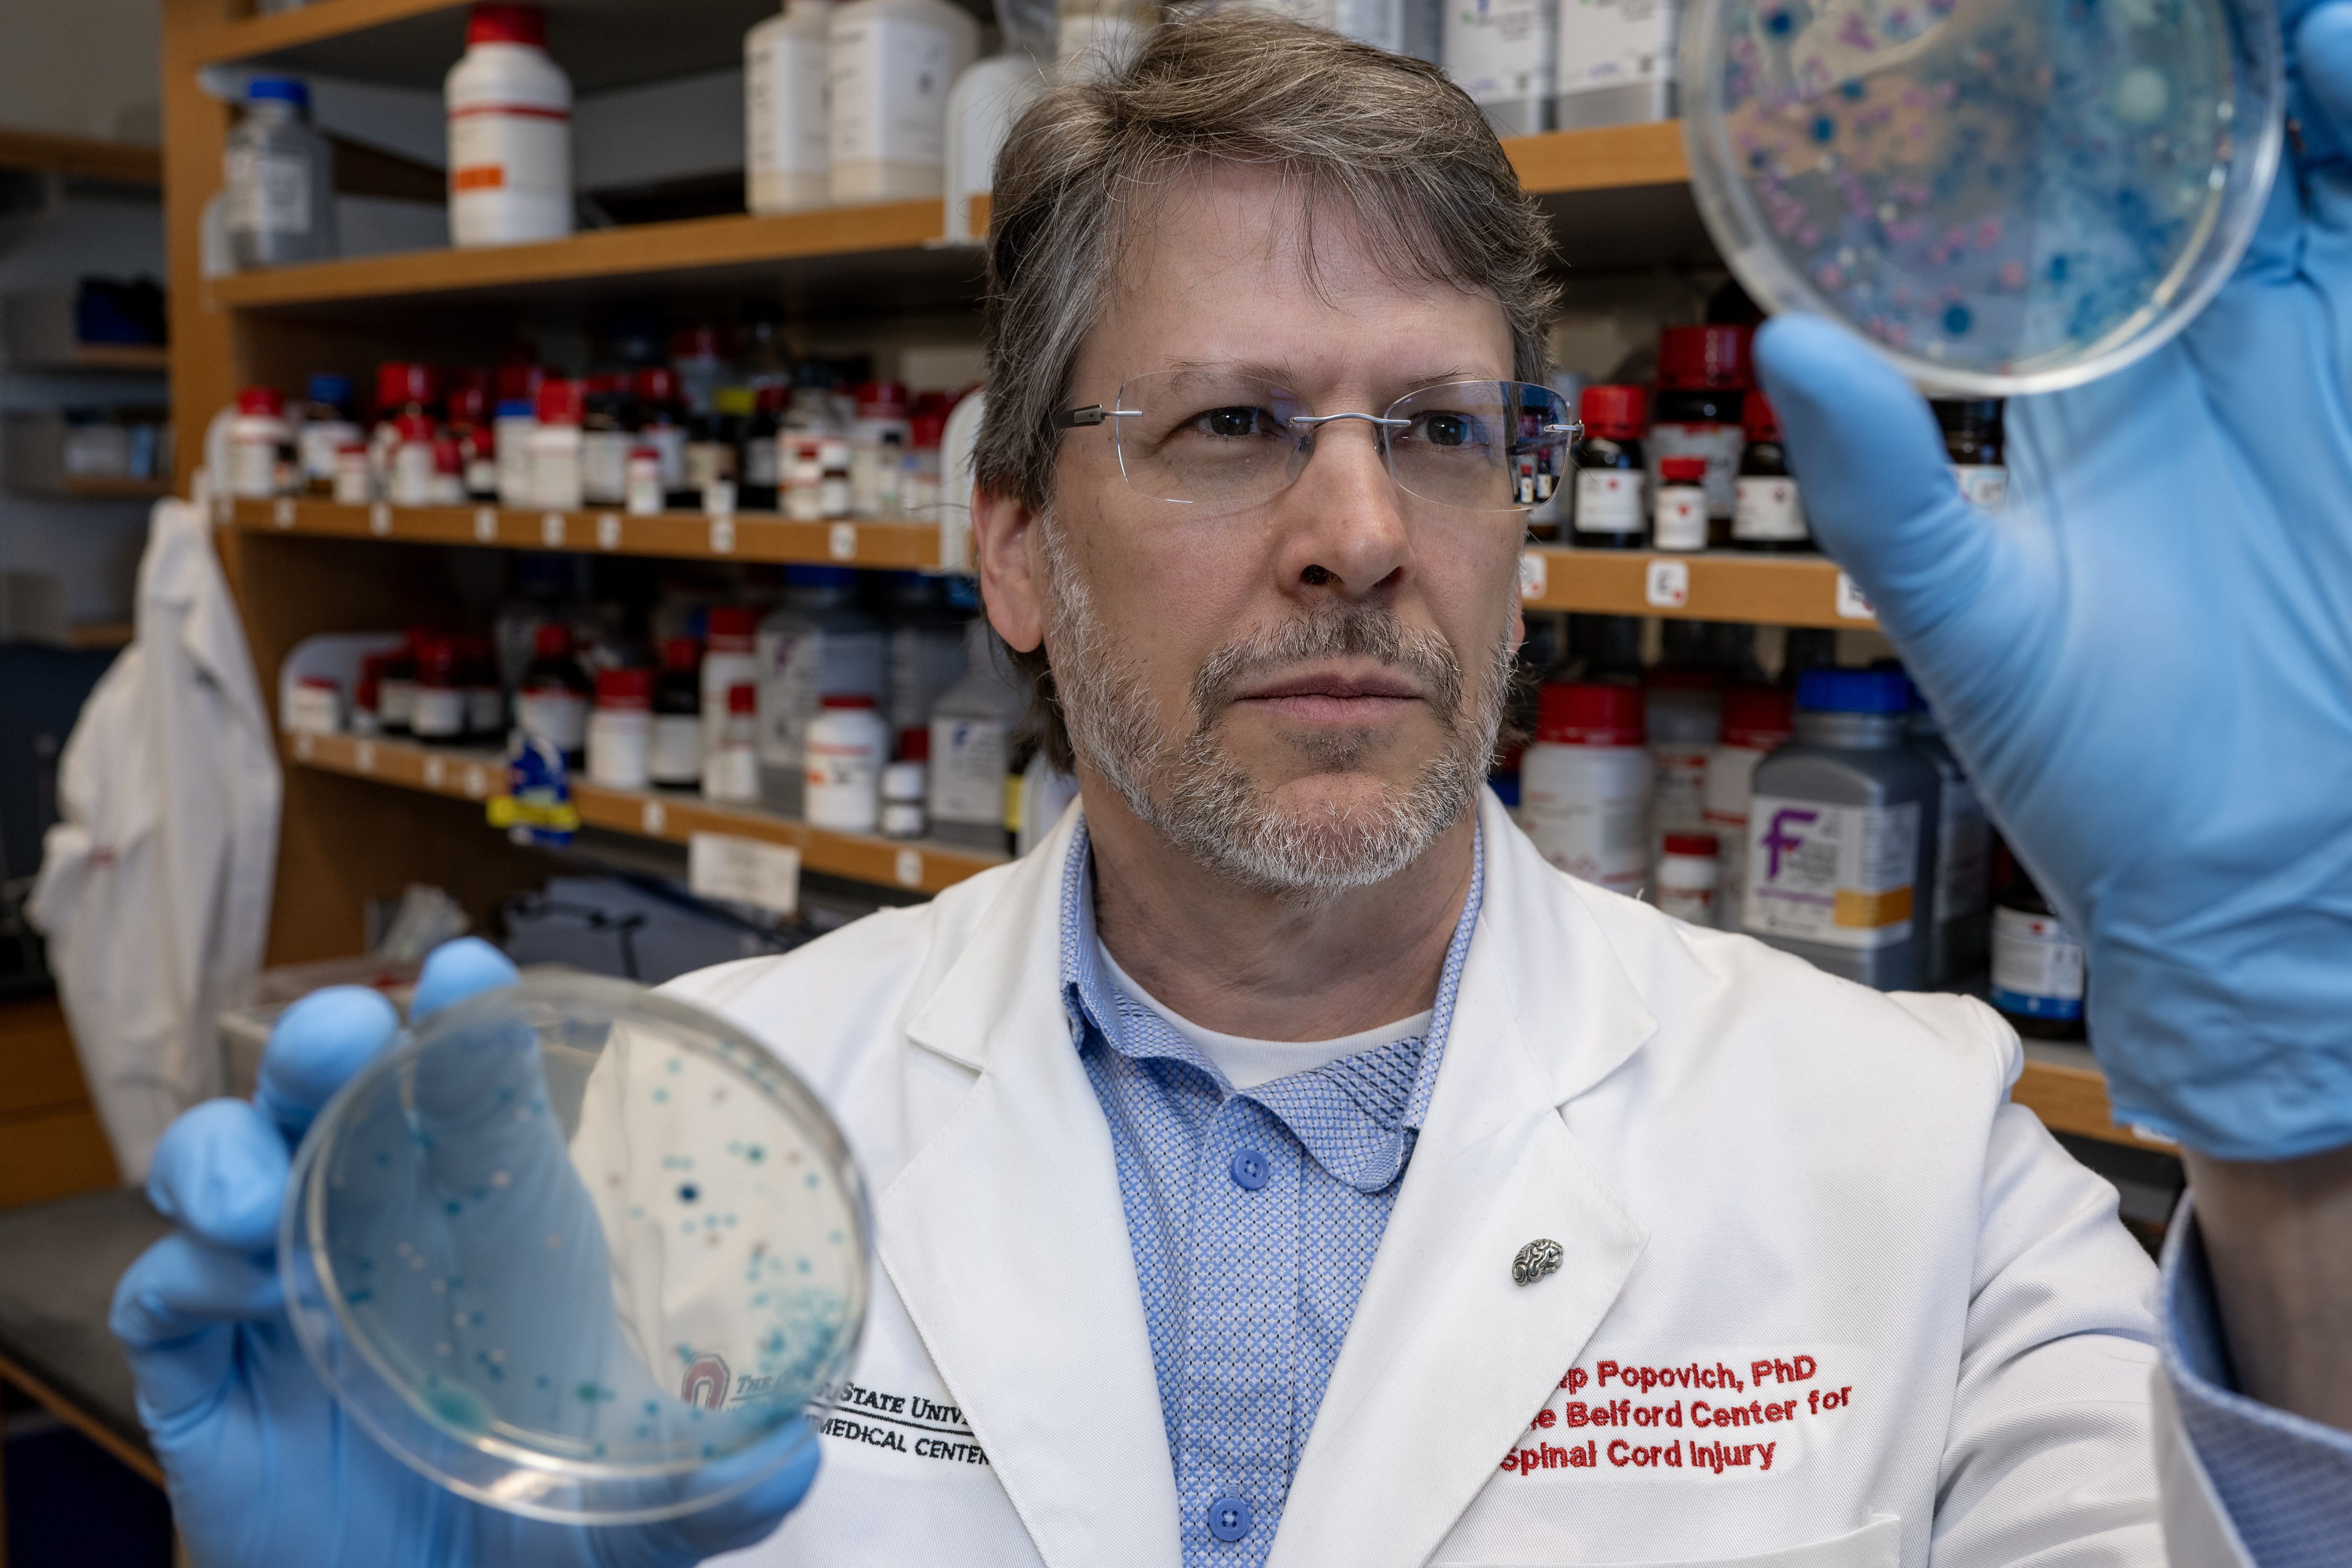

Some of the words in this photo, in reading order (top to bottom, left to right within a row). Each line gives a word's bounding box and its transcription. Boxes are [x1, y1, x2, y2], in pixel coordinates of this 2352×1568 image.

[1597, 1361, 1744, 1393] Popovich,
[1751, 1355, 1816, 1387] PhD
[839, 1381, 905, 1413] STATE
[912, 1396, 968, 1425] UNIV
[1566, 1399, 1682, 1428] Belford
[1690, 1400, 1797, 1428] Center
[1807, 1387, 1852, 1415] for
[819, 1418, 907, 1453] MEDICAL
[1501, 1440, 1597, 1476] Spinal
[1607, 1439, 1682, 1468] Cord
[1689, 1441, 1776, 1474] Injury
